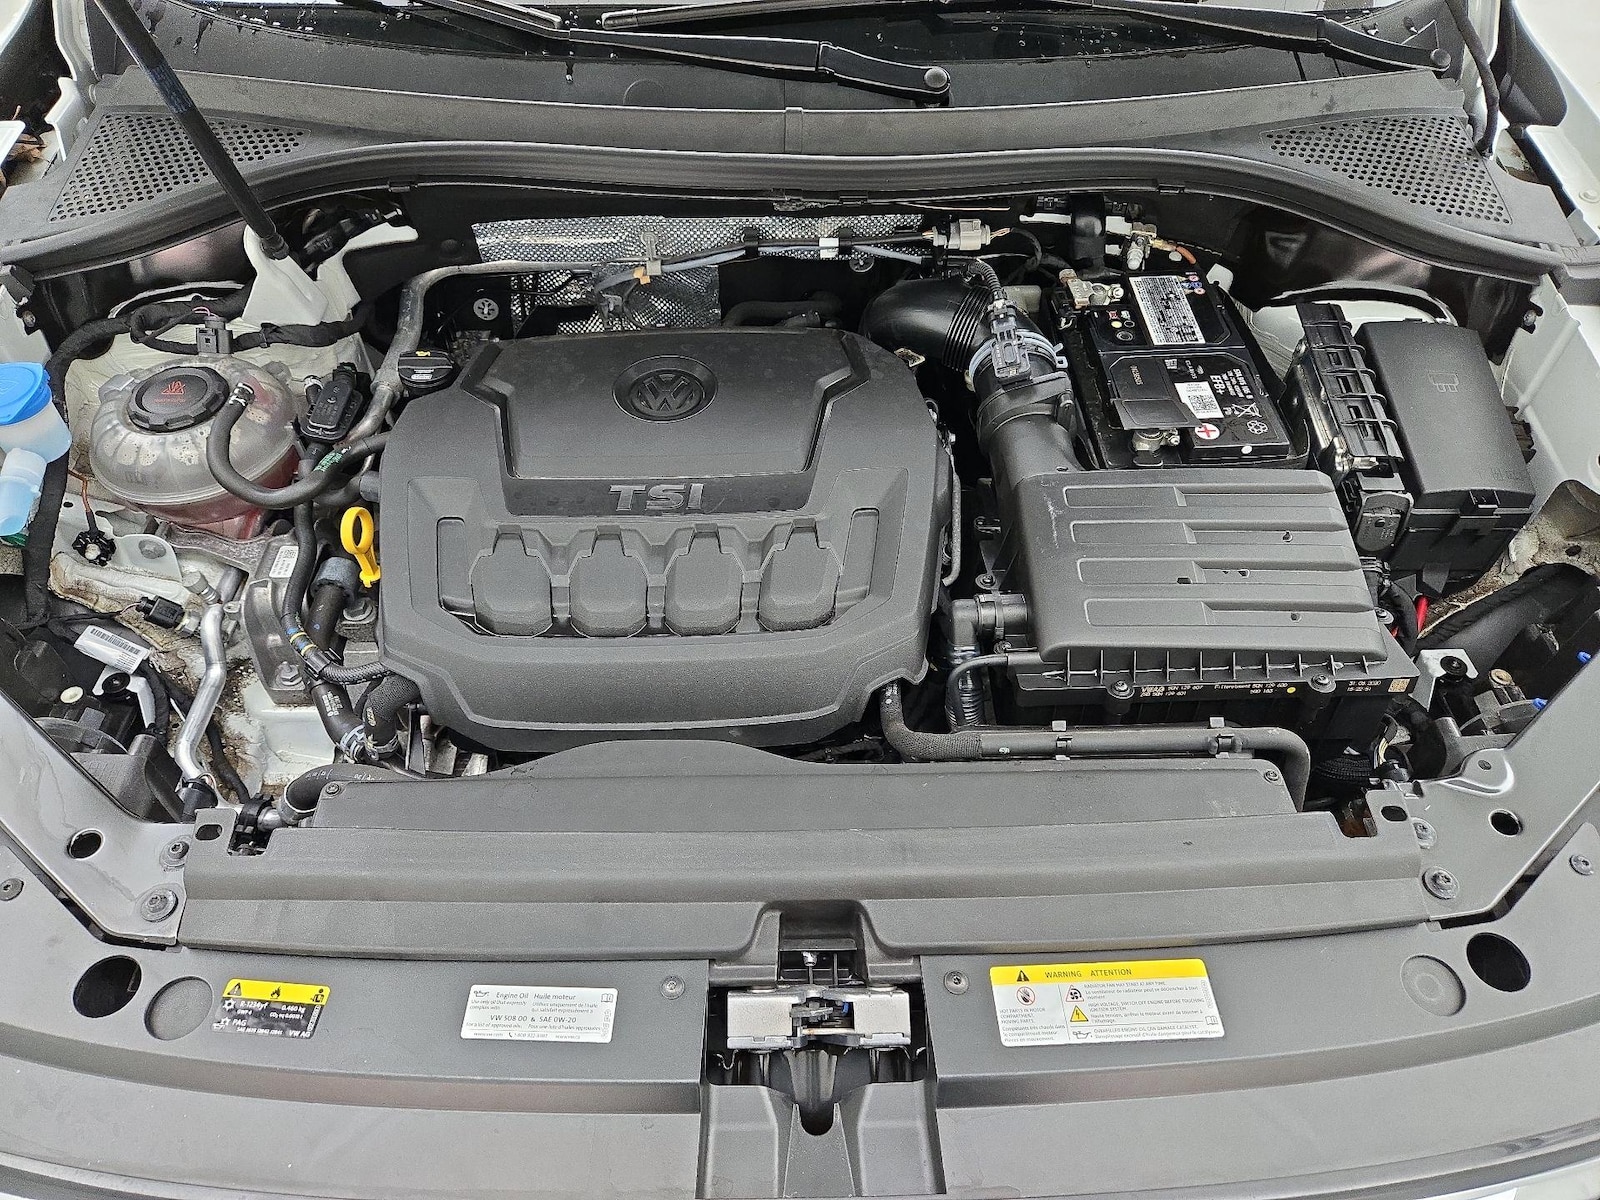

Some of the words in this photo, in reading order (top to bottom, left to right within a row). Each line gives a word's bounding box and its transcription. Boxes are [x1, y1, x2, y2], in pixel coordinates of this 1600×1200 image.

[1210, 375, 1226, 395] EFB+
[609, 483, 705, 511] TSI
[1045, 970, 1082, 979] WARNING
[1090, 968, 1132, 977] ATTENTION
[496, 991, 519, 1000] Engine
[533, 992, 551, 1000] Huile
[240, 1000, 269, 1010] R-1234yf
[281, 1004, 299, 1012] 0.460
[299, 1006, 306, 1014] kg
[232, 1019, 248, 1027] PAG
[300, 1030, 311, 1038] AG
